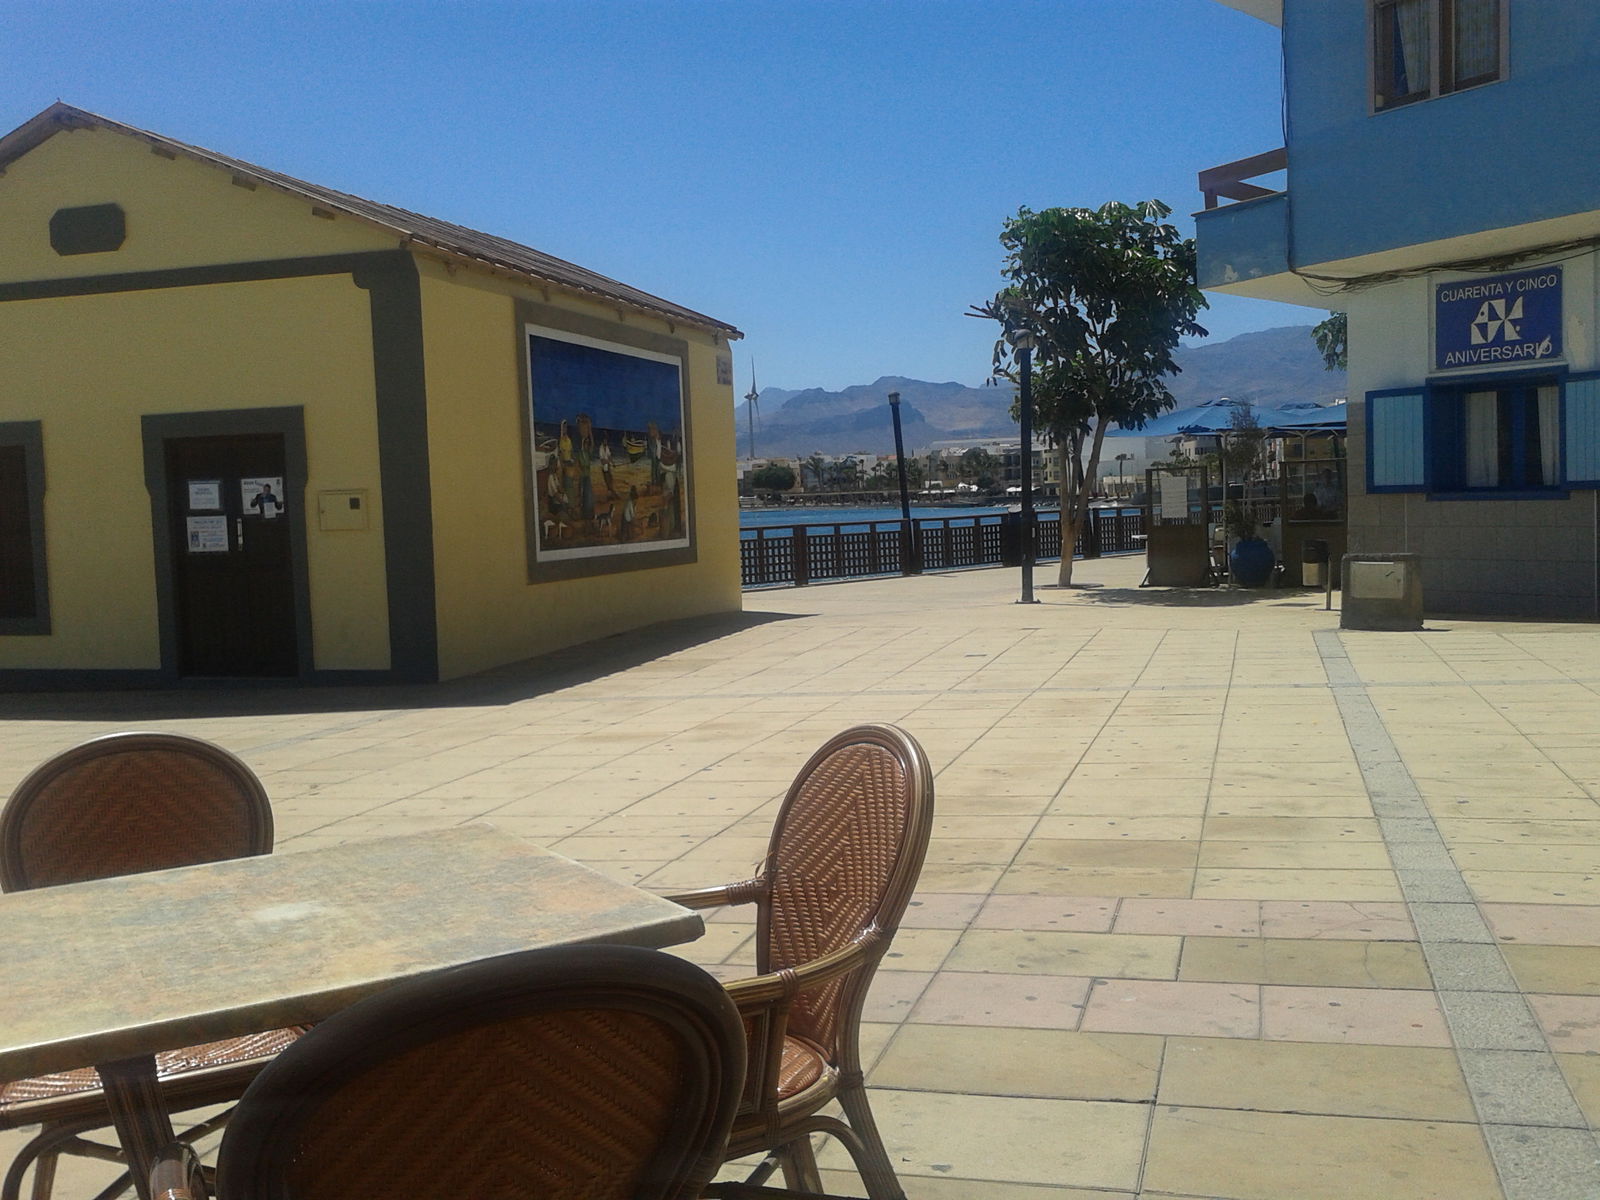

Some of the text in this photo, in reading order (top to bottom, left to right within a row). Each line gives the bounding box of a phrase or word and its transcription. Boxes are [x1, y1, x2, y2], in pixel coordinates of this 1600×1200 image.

[1441, 274, 1557, 302] CUARENTA Y CINCO
[1445, 342, 1552, 364] ANIVERSARIO
